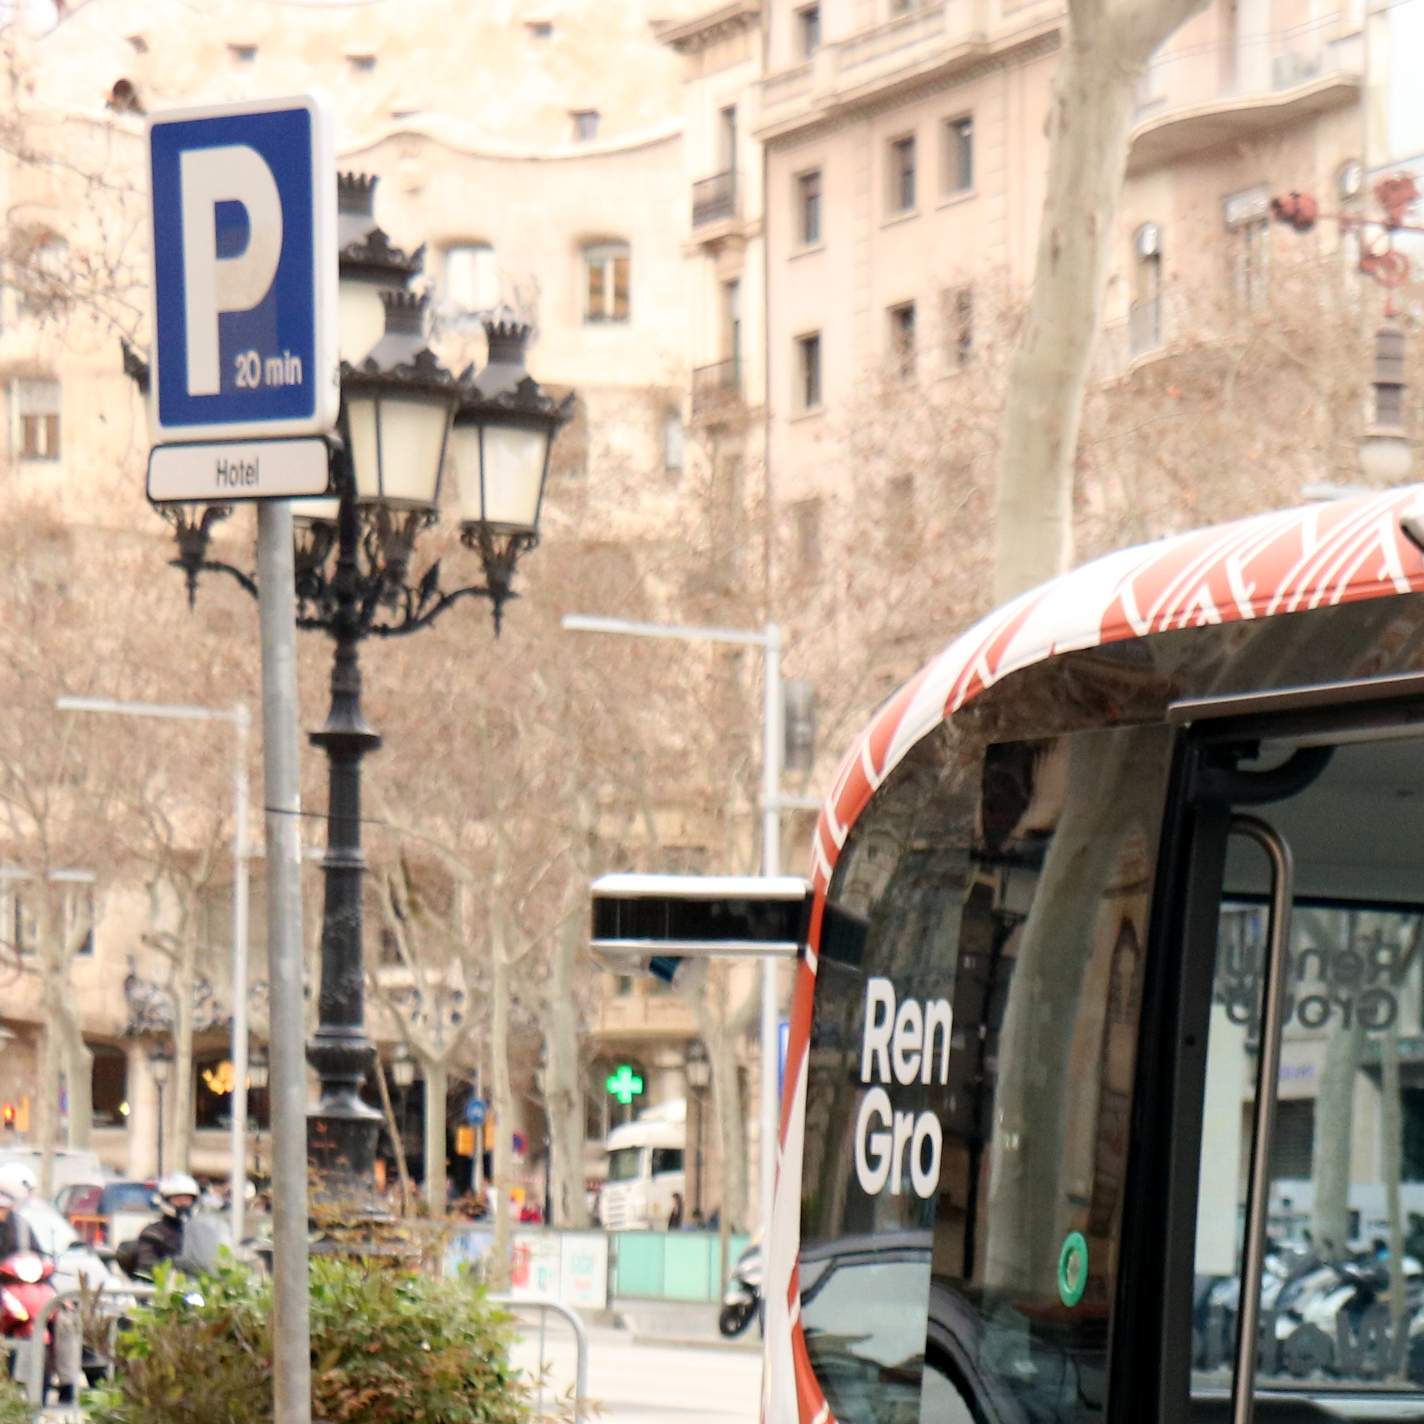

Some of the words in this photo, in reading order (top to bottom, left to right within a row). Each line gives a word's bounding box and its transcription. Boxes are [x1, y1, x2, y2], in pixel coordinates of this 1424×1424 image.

[179, 143, 283, 396] P
[234, 350, 262, 388] 20
[264, 348, 302, 386] min
[215, 456, 260, 488] Hotel
[860, 976, 953, 1086] Ren
[855, 1087, 943, 1200] Gro
